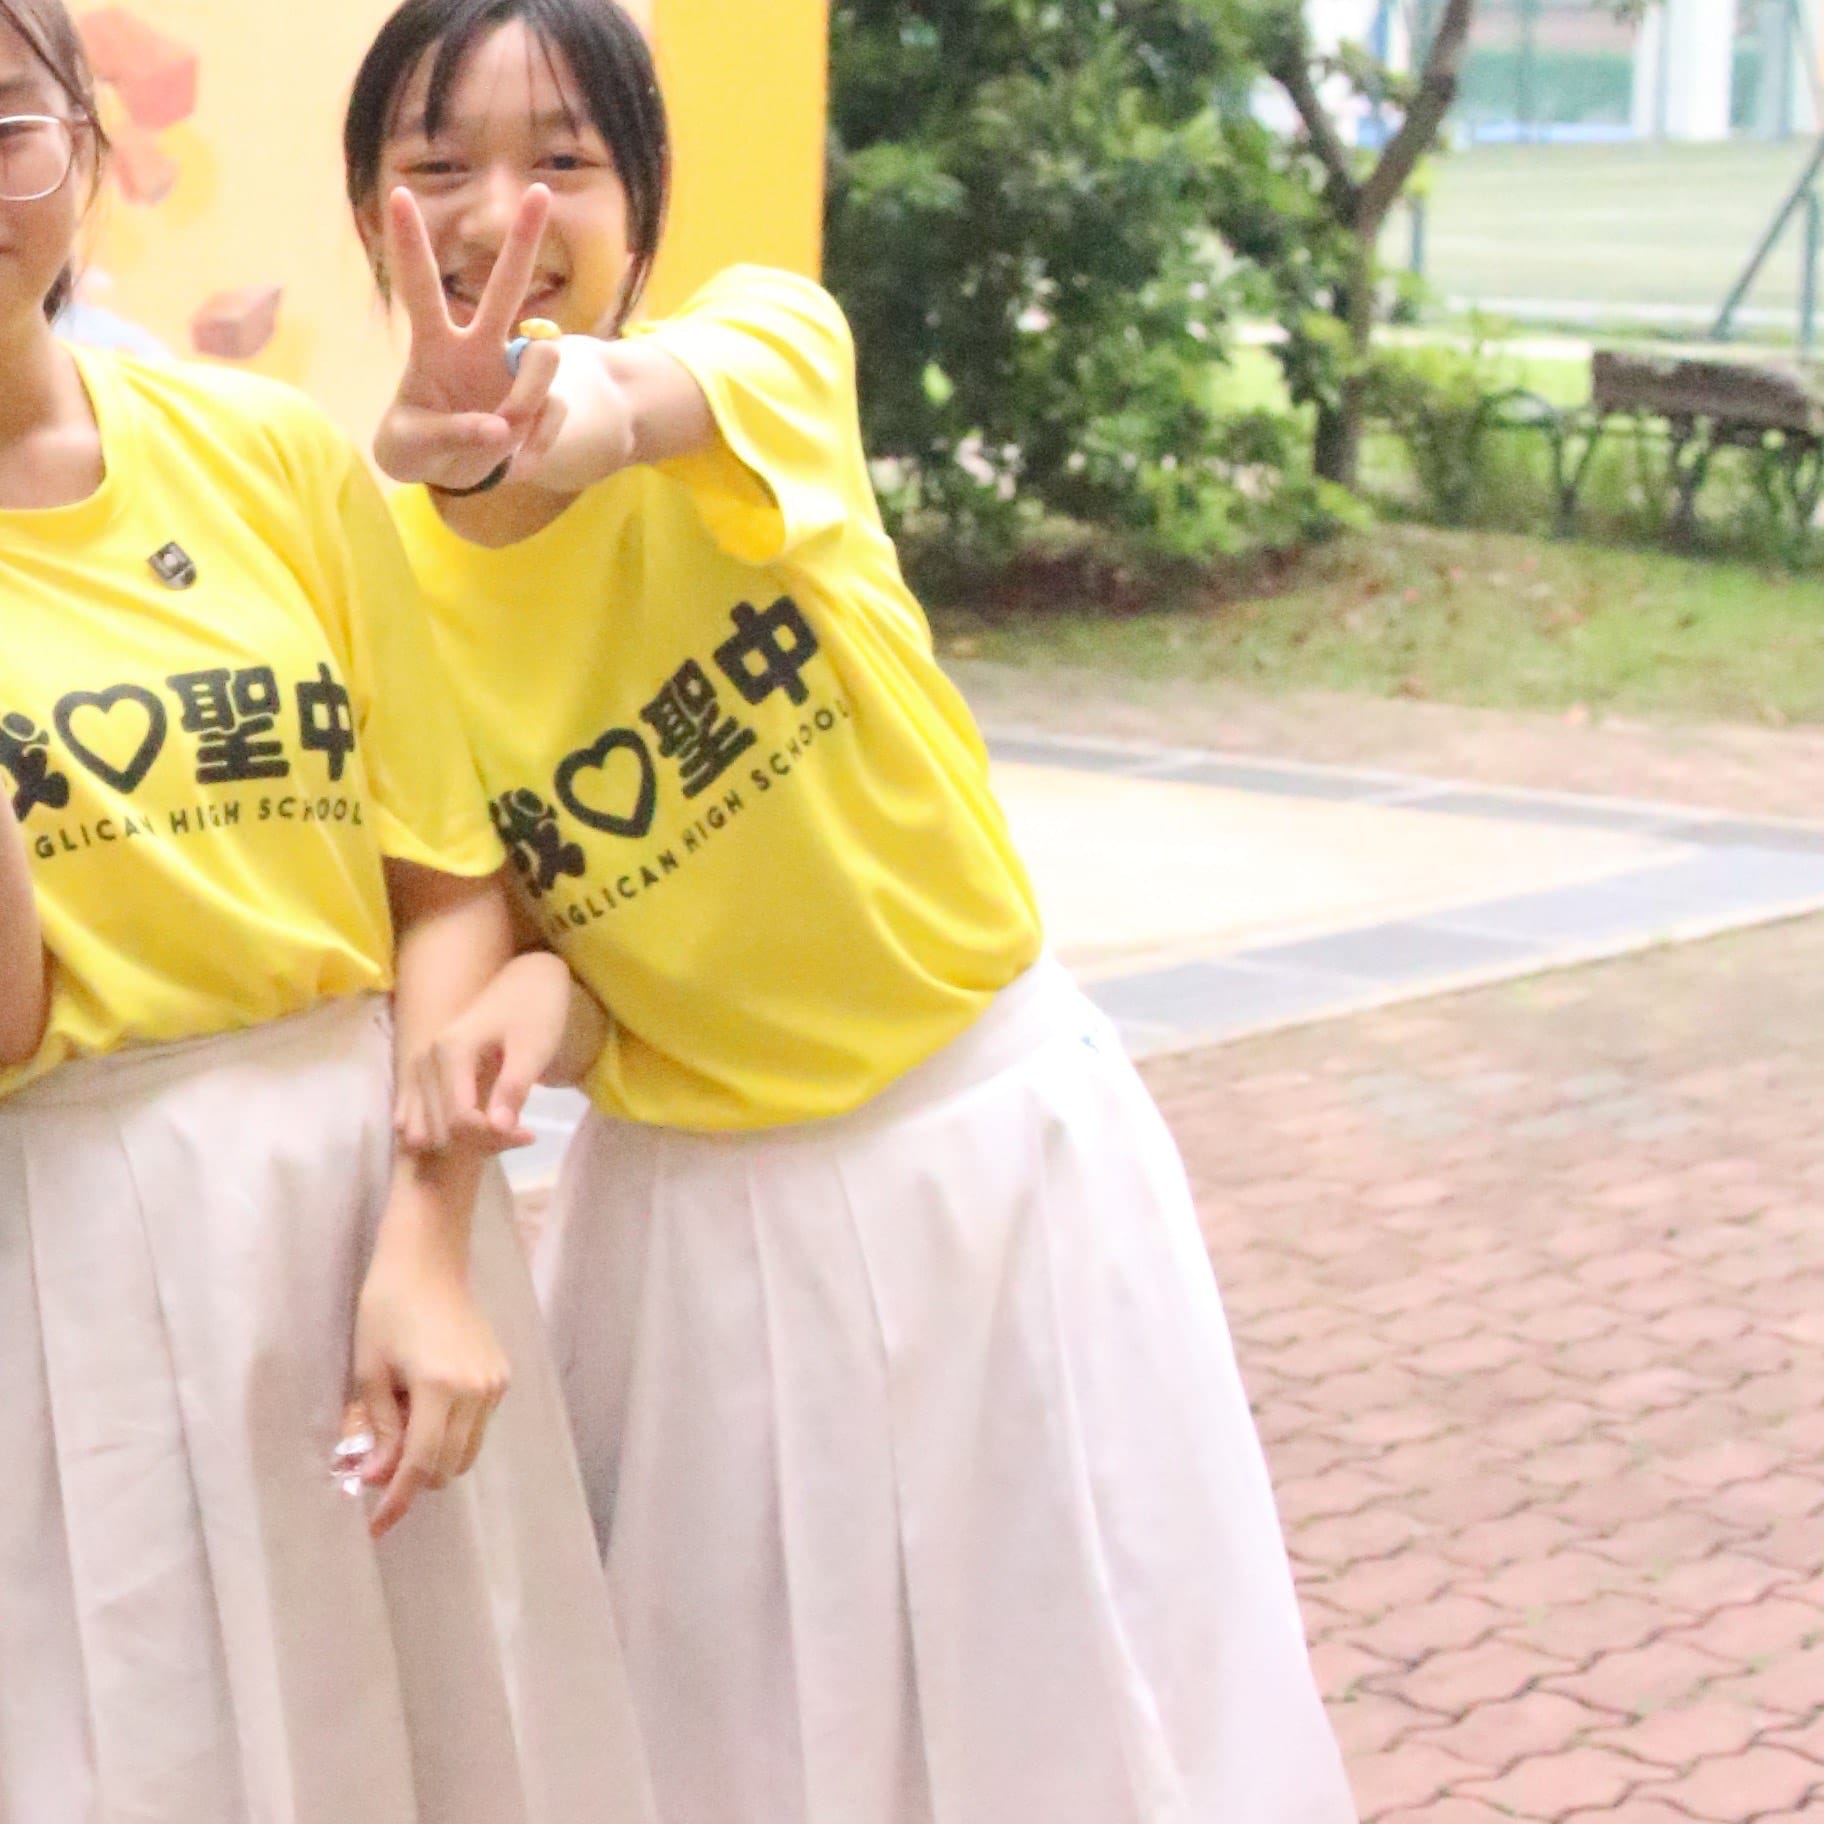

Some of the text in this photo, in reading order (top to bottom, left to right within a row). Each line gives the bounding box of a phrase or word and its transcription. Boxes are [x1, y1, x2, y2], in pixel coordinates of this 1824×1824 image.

[640, 595, 819, 799] 聖中
[169, 799, 240, 834] HIGH
[258, 795, 362, 825] SCHOOL
[682, 789, 745, 854] HIGH
[750, 699, 850, 793] SCHOOL
